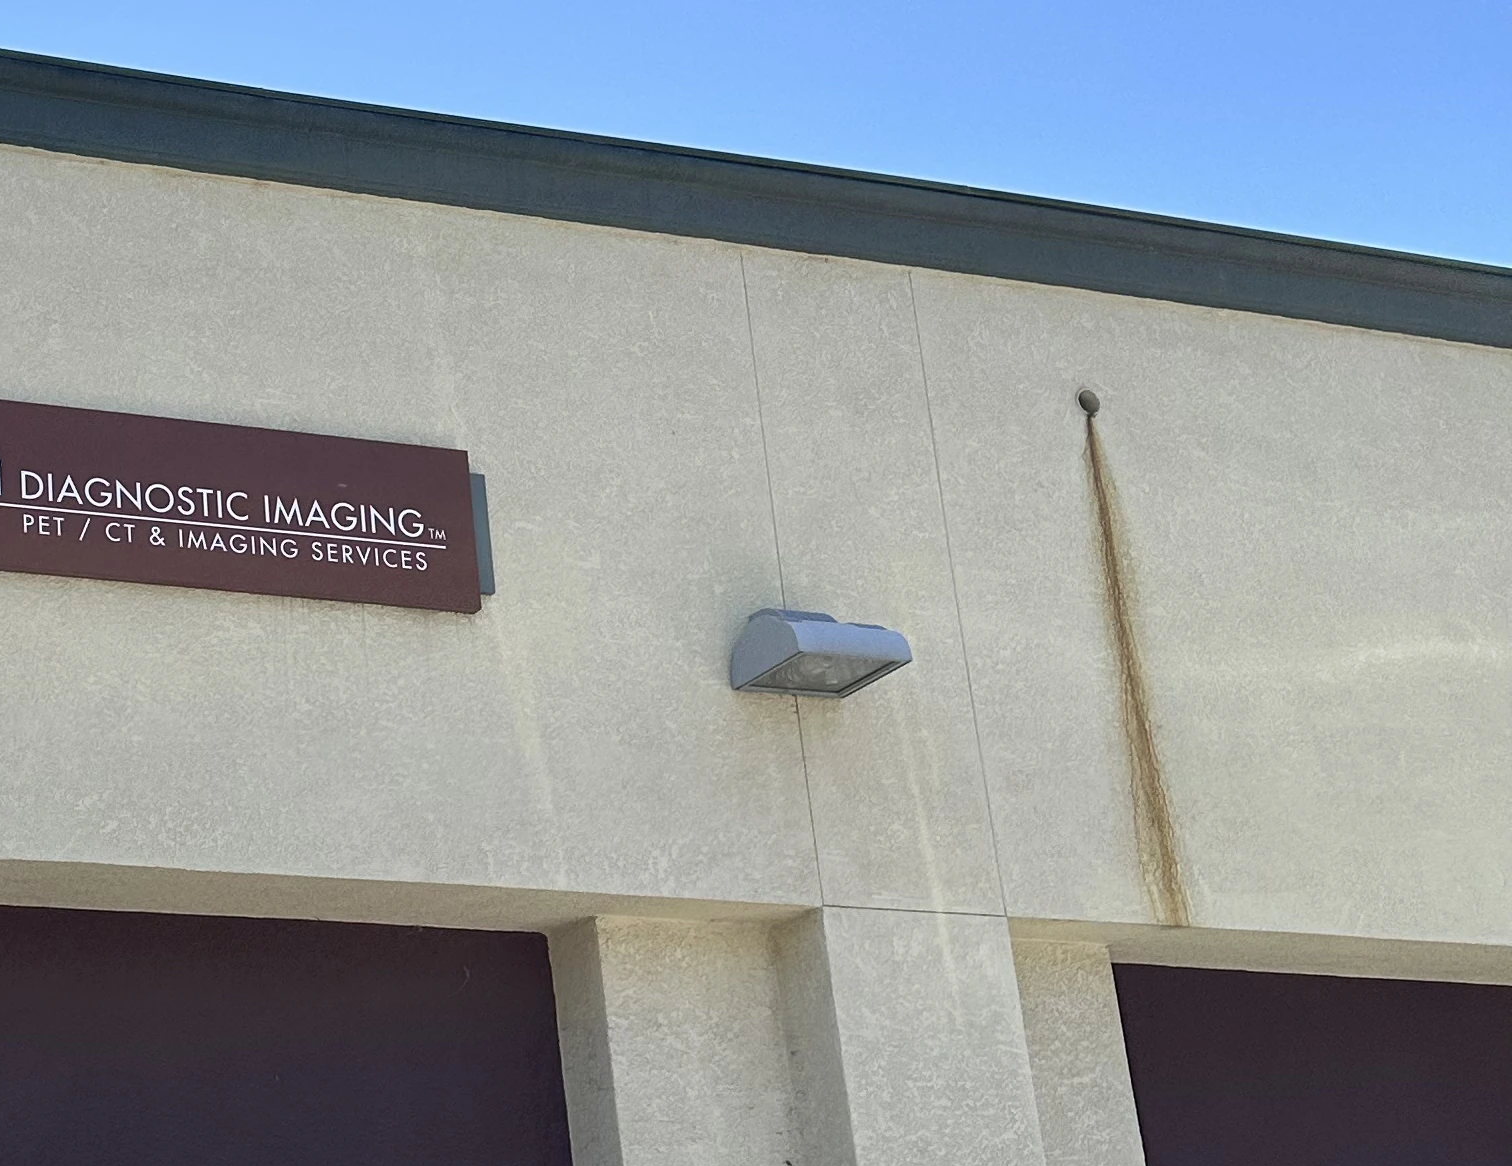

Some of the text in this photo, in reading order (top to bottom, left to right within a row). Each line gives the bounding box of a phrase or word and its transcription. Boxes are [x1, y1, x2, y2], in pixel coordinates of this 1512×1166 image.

[20, 470, 249, 521] DIAGNOSTIC
[264, 495, 424, 537] IMAGING
[23, 514, 428, 571] PET / CT & IMAGING SERVICES
